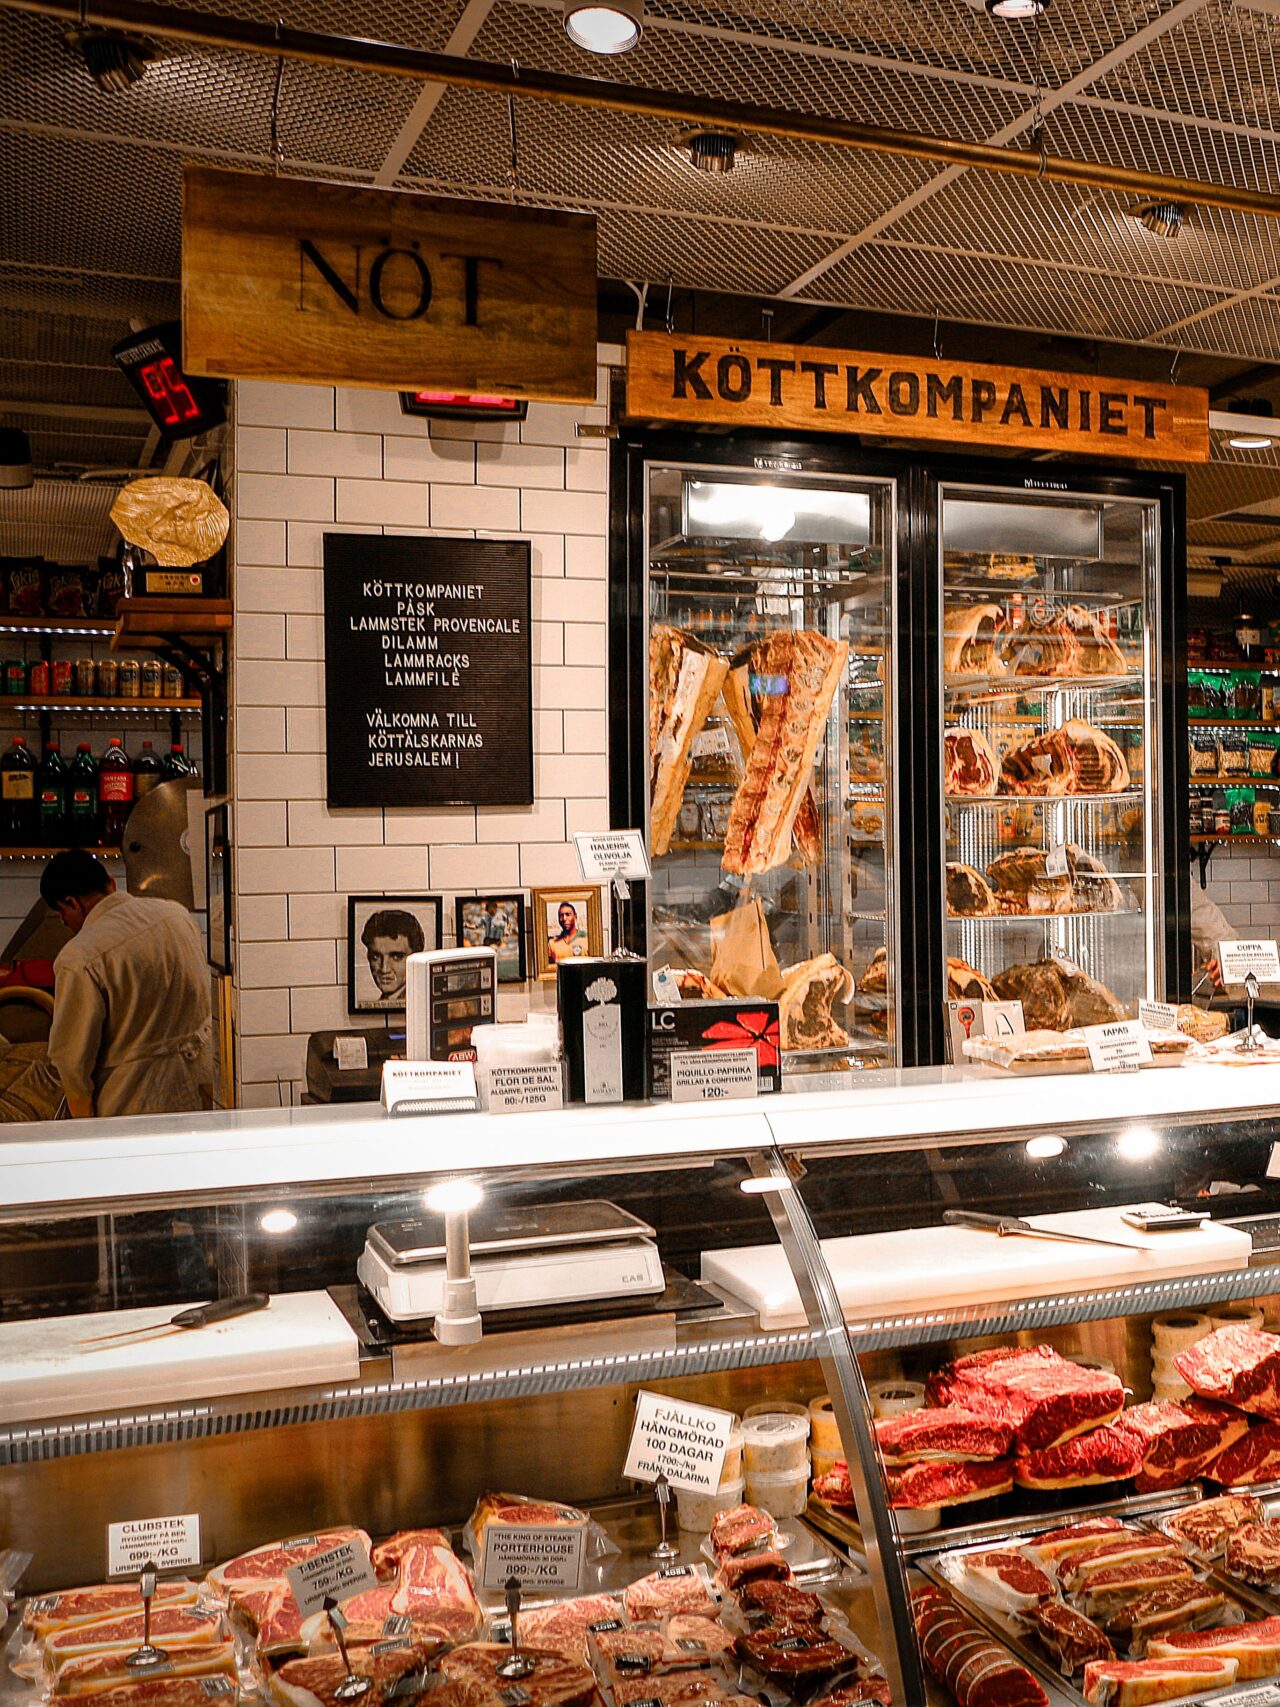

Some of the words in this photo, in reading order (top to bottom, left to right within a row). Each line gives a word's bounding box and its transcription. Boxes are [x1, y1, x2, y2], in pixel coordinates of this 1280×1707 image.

[300, 237, 501, 327] NÖT
[672, 346, 1167, 441] KÖTTKOMPANIET
[363, 578, 484, 600] KÖTTKOMPANIET
[397, 598, 435, 617] PÅSK
[350, 617, 425, 632] LAMMSTEK
[382, 635, 438, 650] DILAMM
[384, 654, 470, 669] LAMMRACKS
[366, 708, 439, 728] VÄLKOMNA
[446, 713, 477, 728] TILL
[368, 729, 483, 749] KÖTTÄLSKARNAS
[368, 752, 451, 767] JERUSALEM
[652, 1011, 676, 1030] LC
[1102, 1026, 1129, 1037] TAPAS
[491, 1065, 557, 1076] KÖTTKOMPANIETS
[676, 1065, 752, 1078] PIQUILLO-PAPRIKA
[495, 1077, 520, 1087] FLOR
[522, 1076, 535, 1086] DE
[655, 1408, 716, 1432] FJÄLLKO
[640, 1420, 724, 1449] HÄNGMÖRAD
[646, 1437, 666, 1451] 100
[669, 1443, 714, 1463] DAGAR
[667, 1468, 710, 1485] DALARNA
[122, 1519, 185, 1534] CLUBSTEK
[513, 1533, 531, 1541] KING
[533, 1533, 542, 1541] OF
[493, 1543, 575, 1554] PORTERHOUSE
[161, 1557, 192, 1568] SVERIGE
[297, 1545, 353, 1575] T-BENSTEK
[505, 1565, 558, 1576] 899:-/KG
